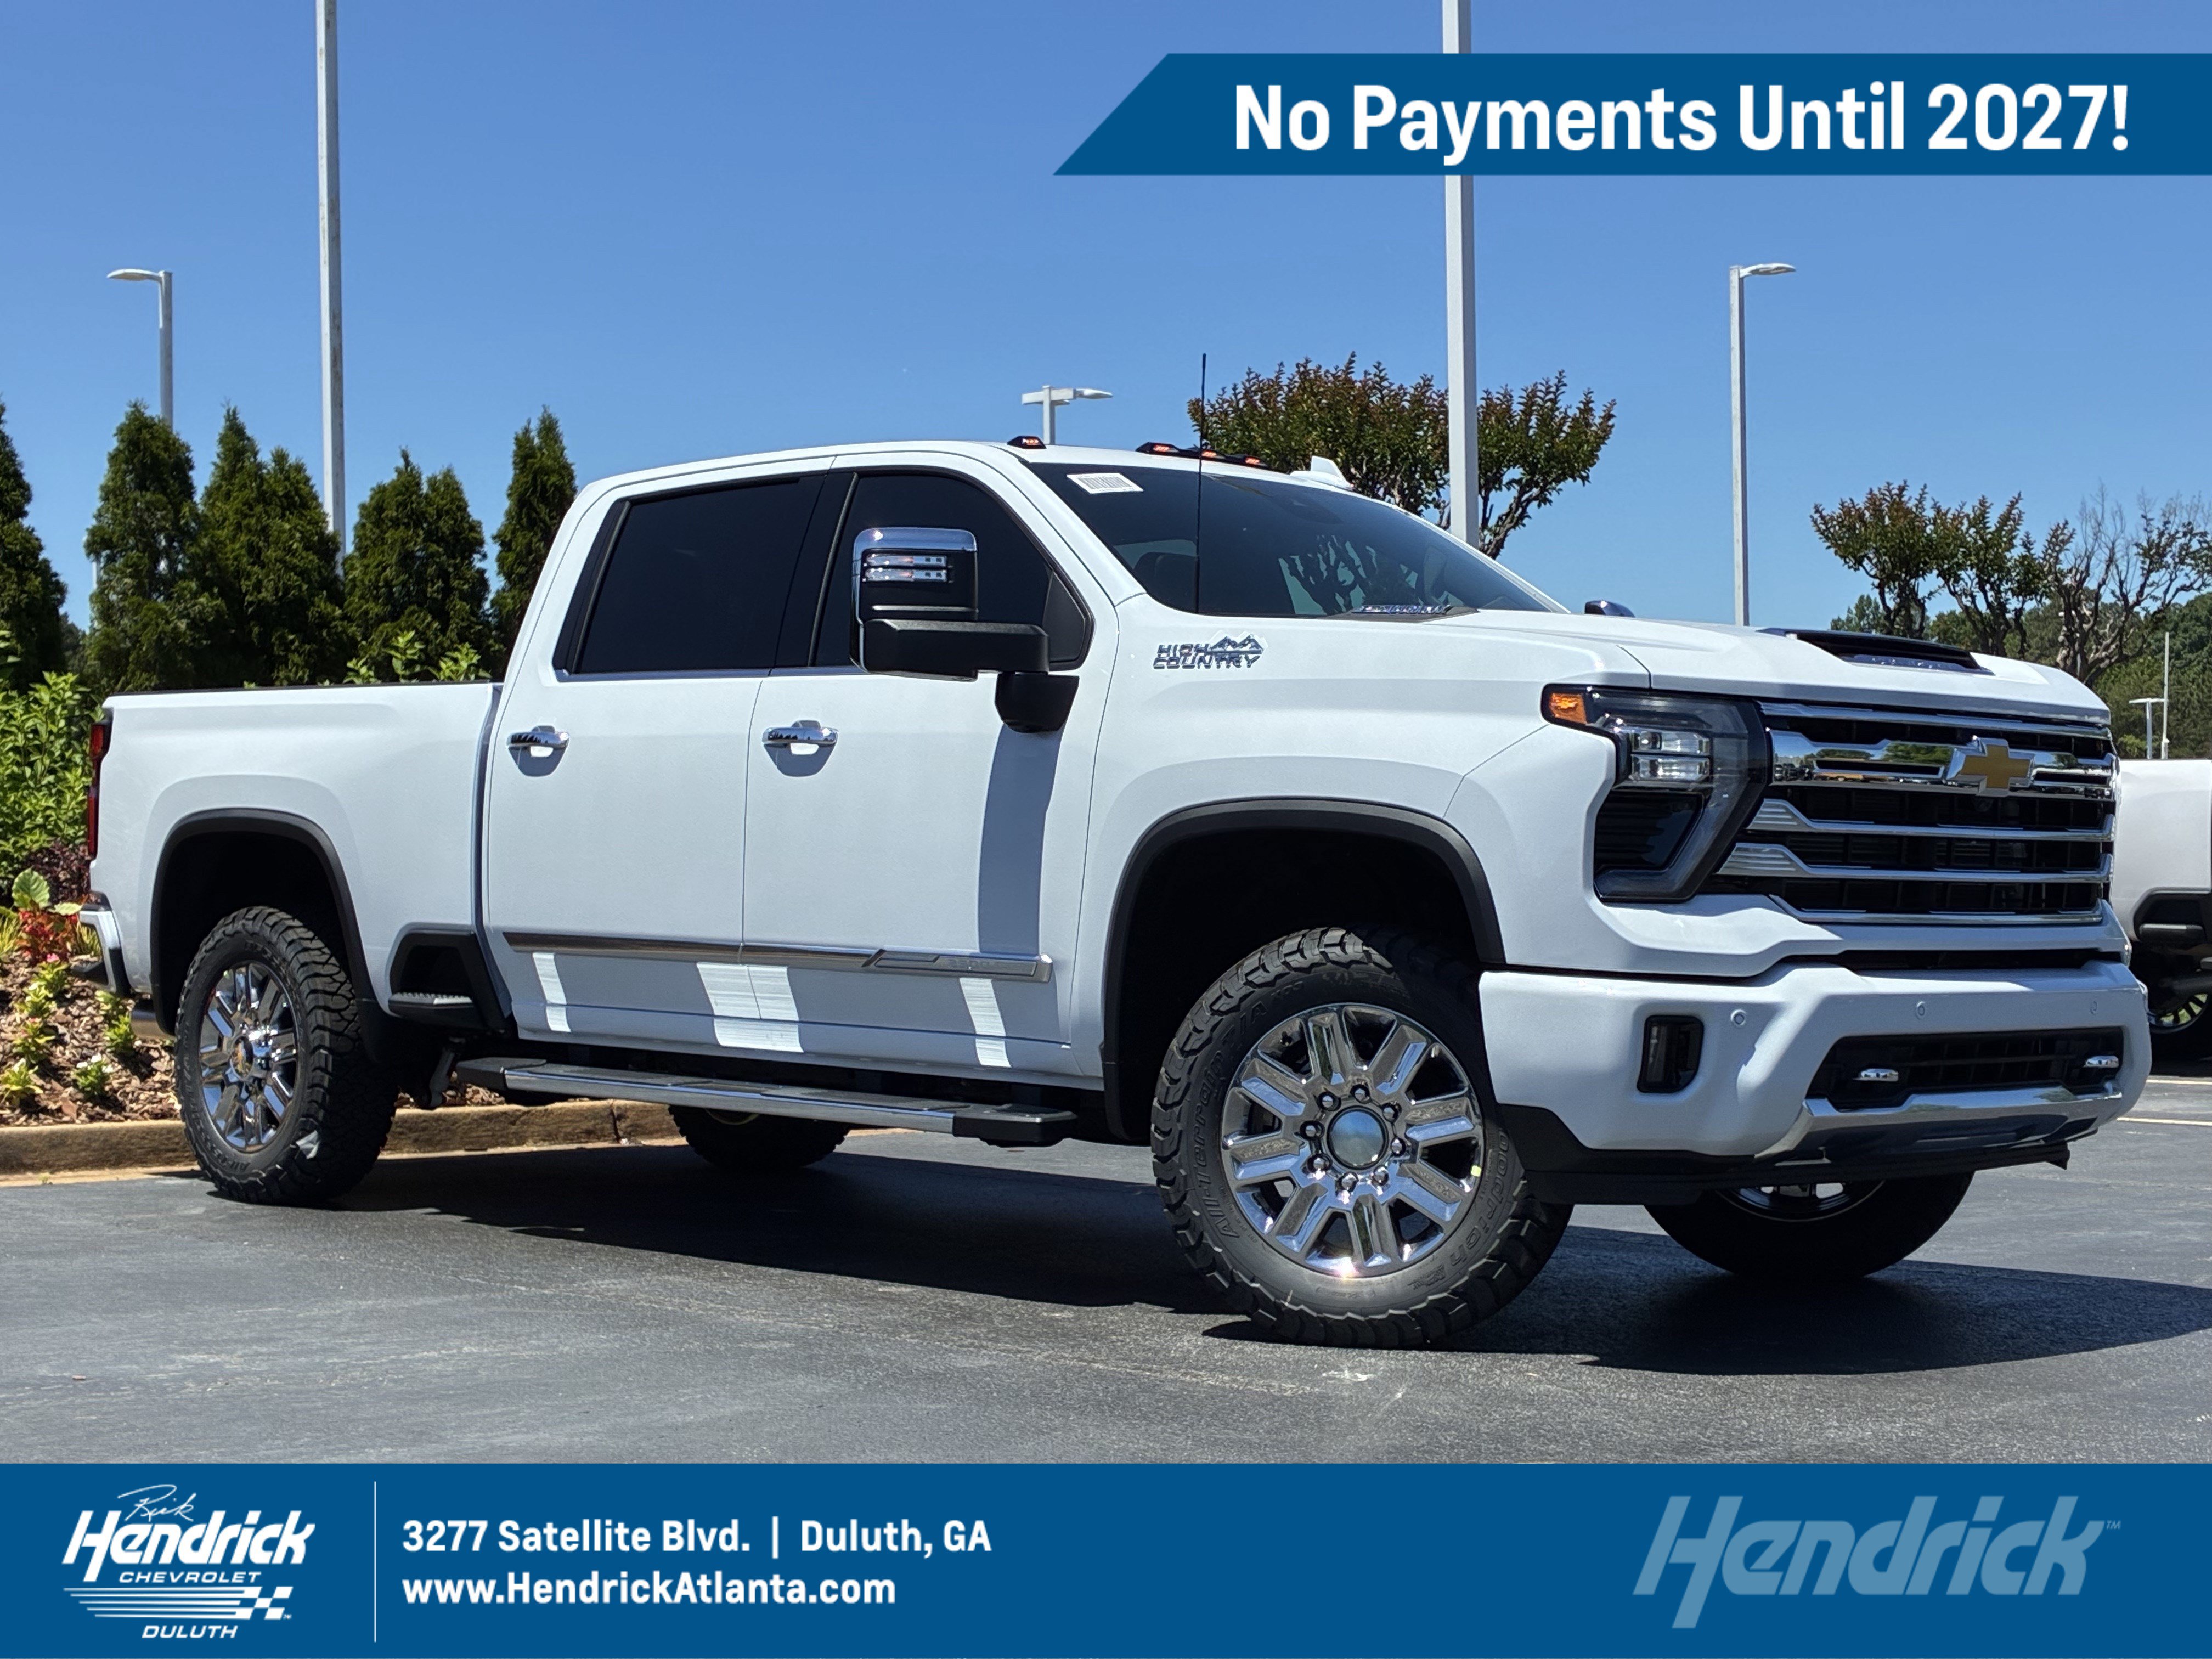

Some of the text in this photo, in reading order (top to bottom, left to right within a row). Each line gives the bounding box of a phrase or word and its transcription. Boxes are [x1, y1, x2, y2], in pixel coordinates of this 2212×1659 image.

[1153, 655, 1261, 669] COUNTRY
[1156, 644, 1210, 657] HIGH
[1193, 1050, 1240, 1239] All-Terrain
[1450, 1127, 1508, 1266] oodrich
